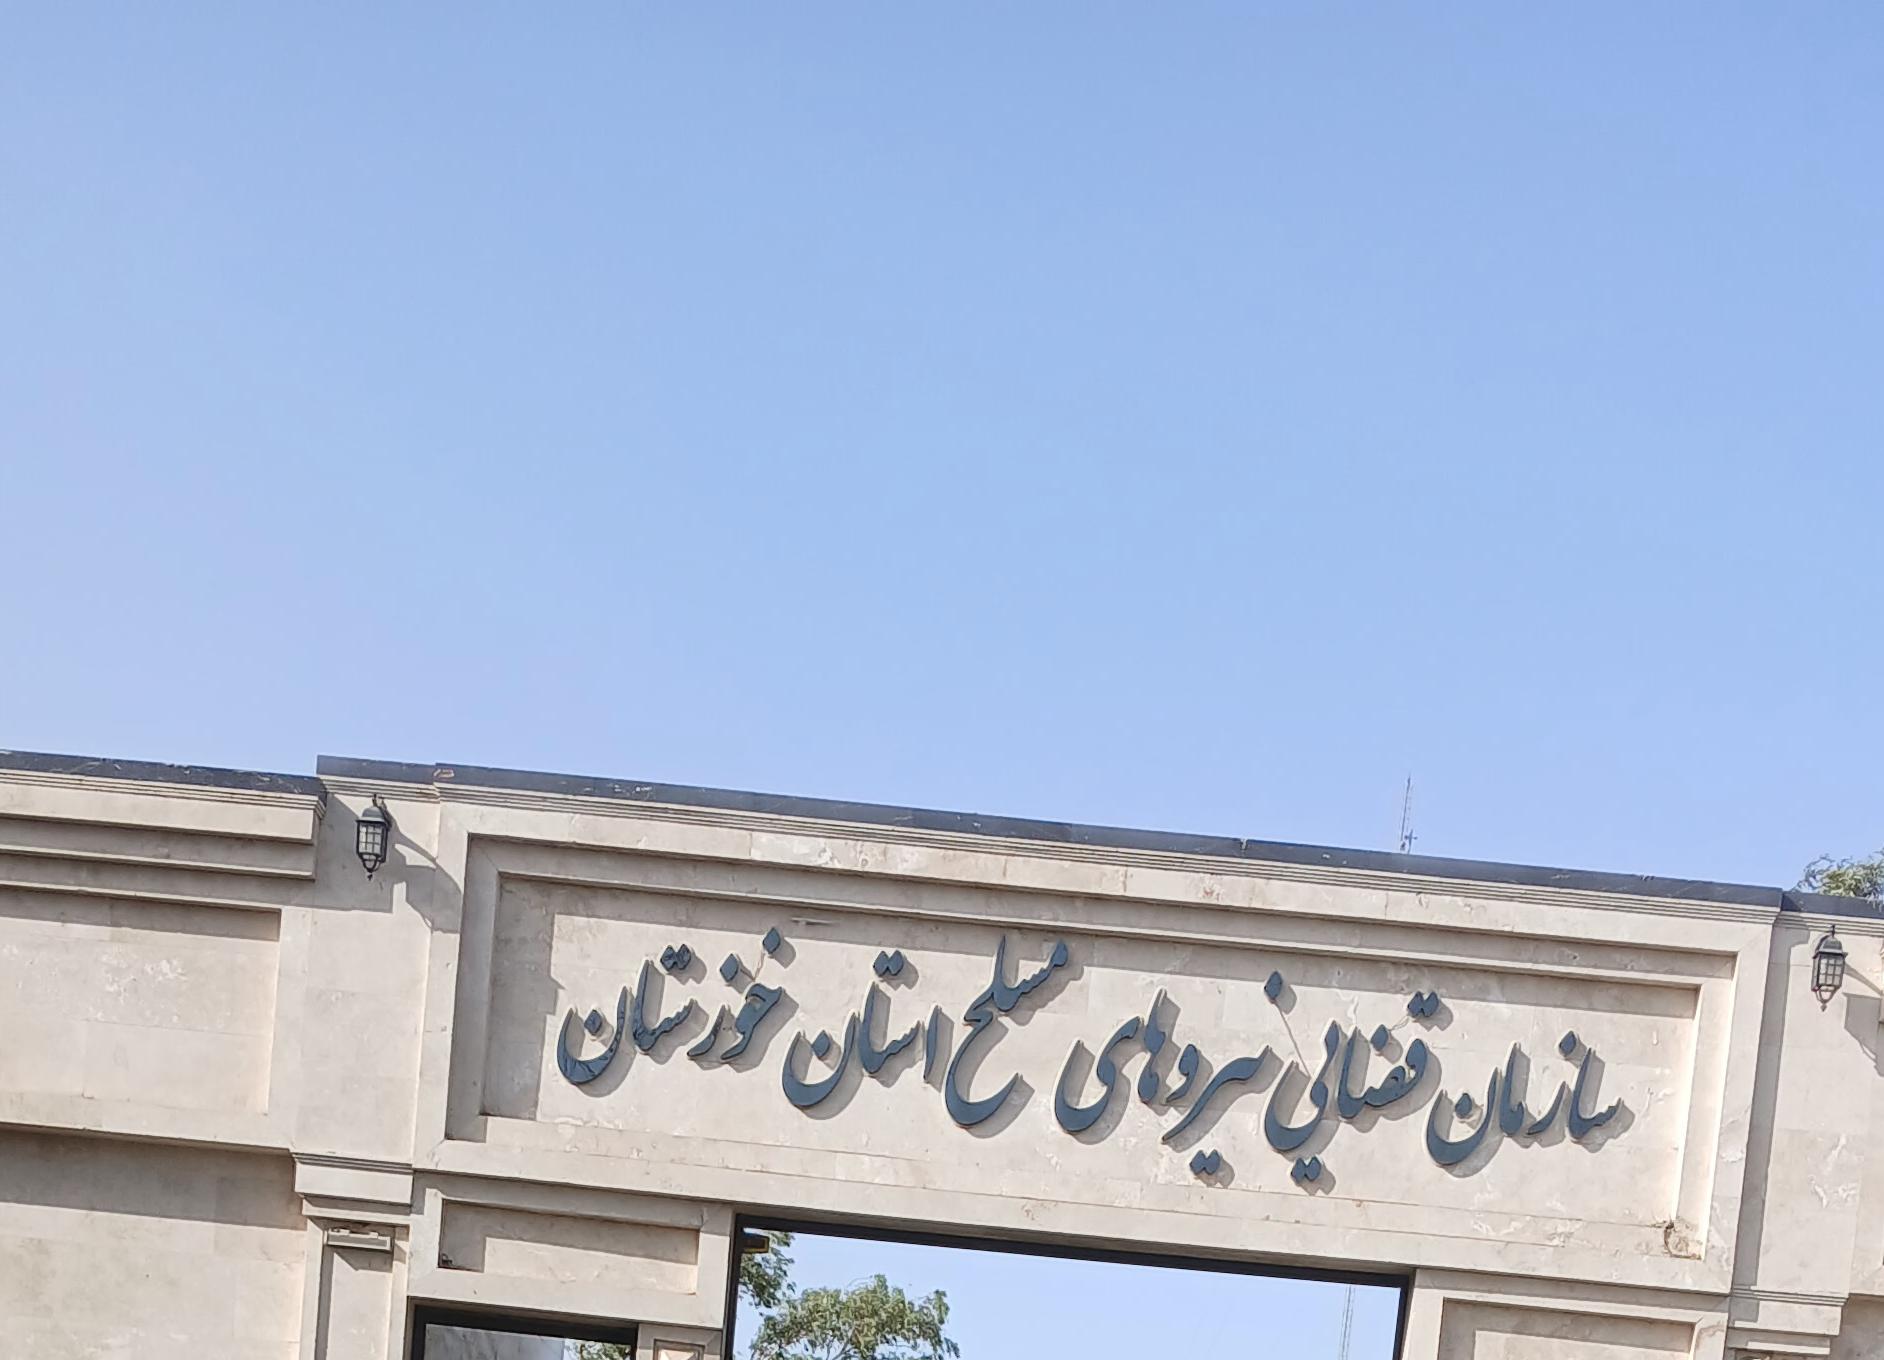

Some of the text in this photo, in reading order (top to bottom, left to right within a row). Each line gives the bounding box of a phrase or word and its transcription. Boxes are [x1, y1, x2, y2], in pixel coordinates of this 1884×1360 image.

[556, 926, 784, 1085] خوزستان
[781, 949, 943, 1108] استان
[944, 935, 1069, 1129] مسلح
[1054, 970, 1284, 1176] نیروهای
[1427, 1030, 1622, 1166] سازمان
